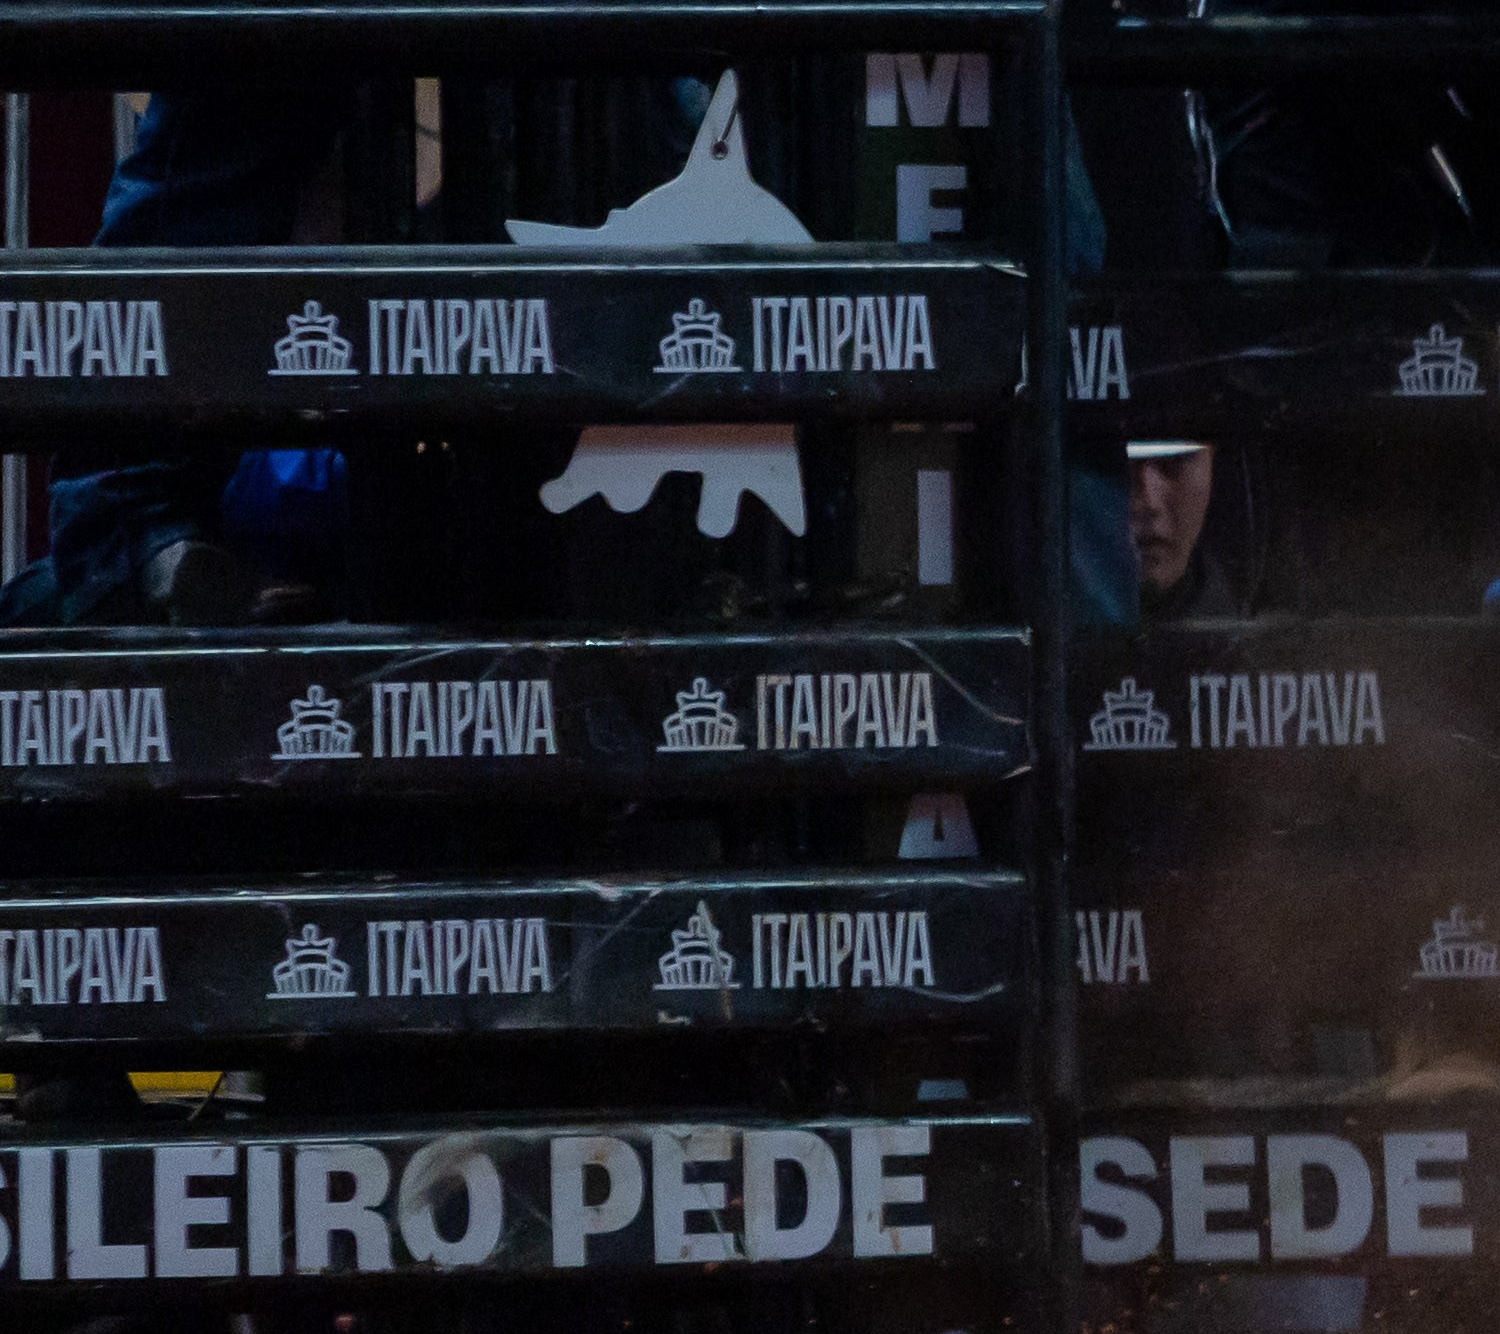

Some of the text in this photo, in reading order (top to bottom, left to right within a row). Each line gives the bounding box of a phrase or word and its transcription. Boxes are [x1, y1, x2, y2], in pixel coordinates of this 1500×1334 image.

[368, 299, 555, 375] ITAIPAVA
[752, 295, 935, 372] ITAIPAVA
[1066, 326, 1131, 400] VA
[372, 680, 558, 757] ITAIPAVA
[756, 673, 938, 749] ITAIPAVA
[1190, 672, 1386, 747] ITAIPAVA
[367, 918, 551, 996] ITAIPAVA
[752, 911, 934, 987] ITAIPAVA
[0, 1125, 935, 1279] ILEIRO PEDE
[1079, 1130, 1474, 1265] SEDE
